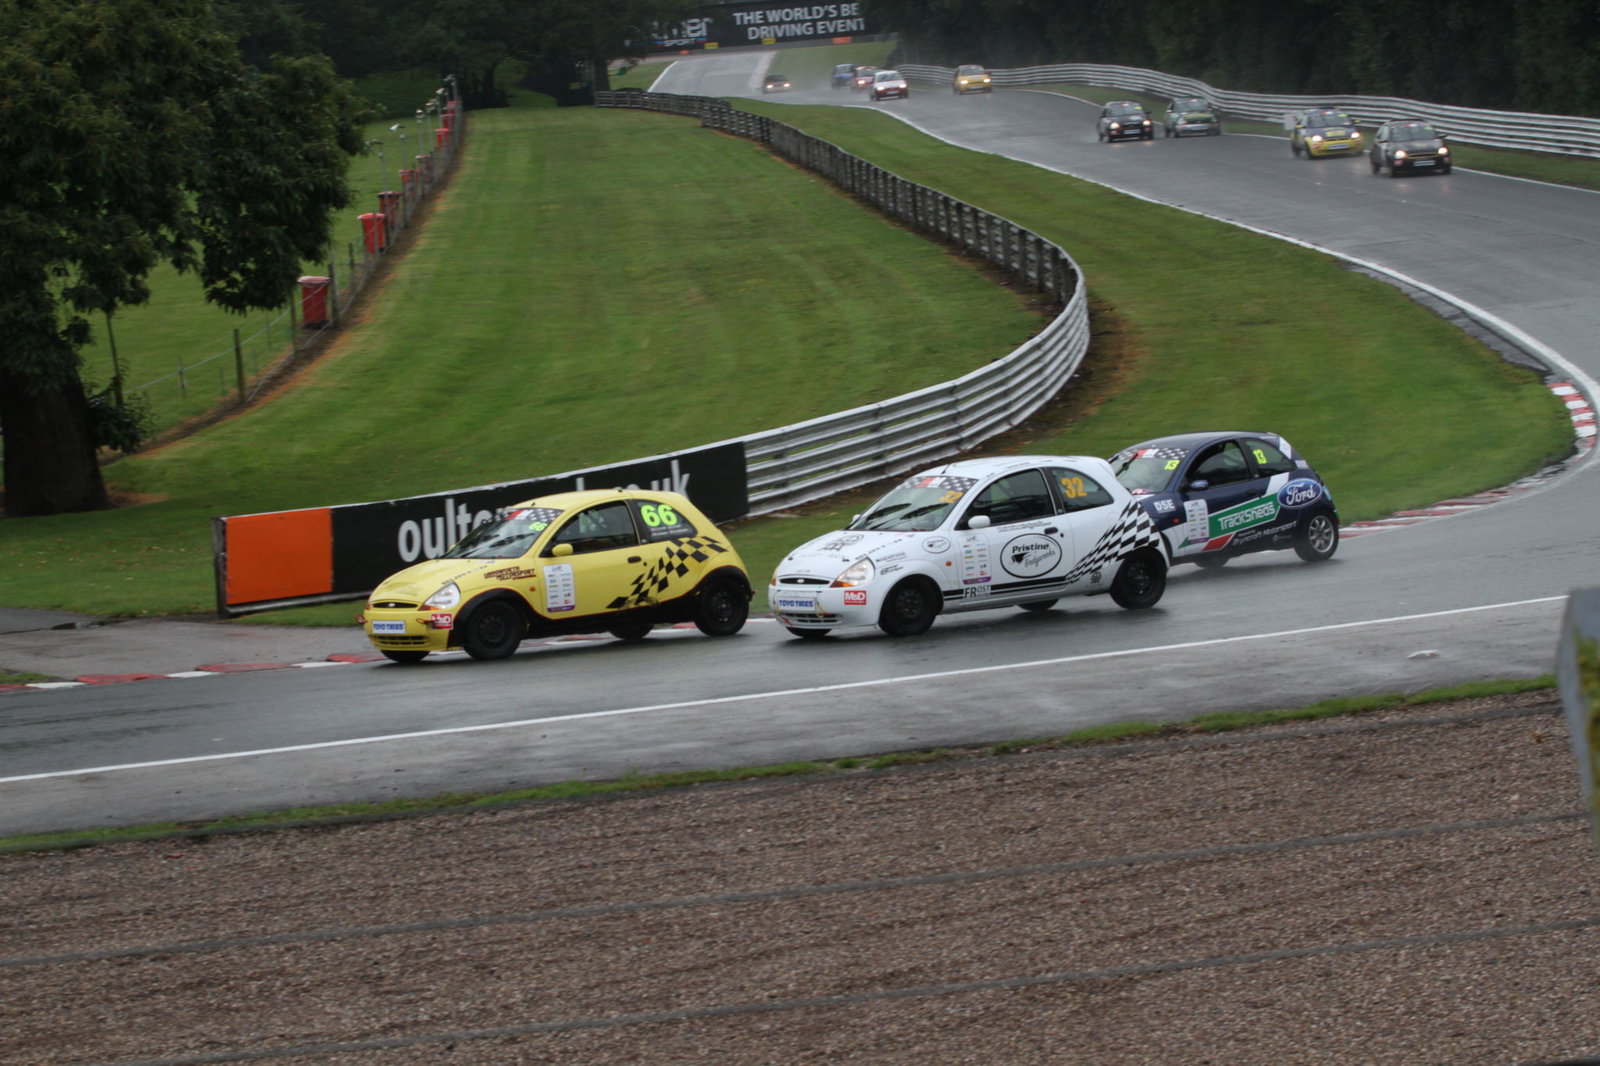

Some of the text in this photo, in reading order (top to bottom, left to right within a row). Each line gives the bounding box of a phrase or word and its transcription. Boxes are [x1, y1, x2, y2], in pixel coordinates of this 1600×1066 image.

[733, 11, 764, 25] THE
[766, 5, 837, 22] WORLD'S
[747, 18, 865, 40] DRIVING EVENT
[1164, 460, 1180, 470] 13
[1252, 449, 1267, 464] 13
[1061, 476, 1088, 498] 32
[1286, 482, 1316, 505] Ford
[1153, 499, 1175, 511] DSE
[641, 504, 677, 527] 66
[528, 521, 547, 531] 66
[1012, 543, 1049, 553] Pristine
